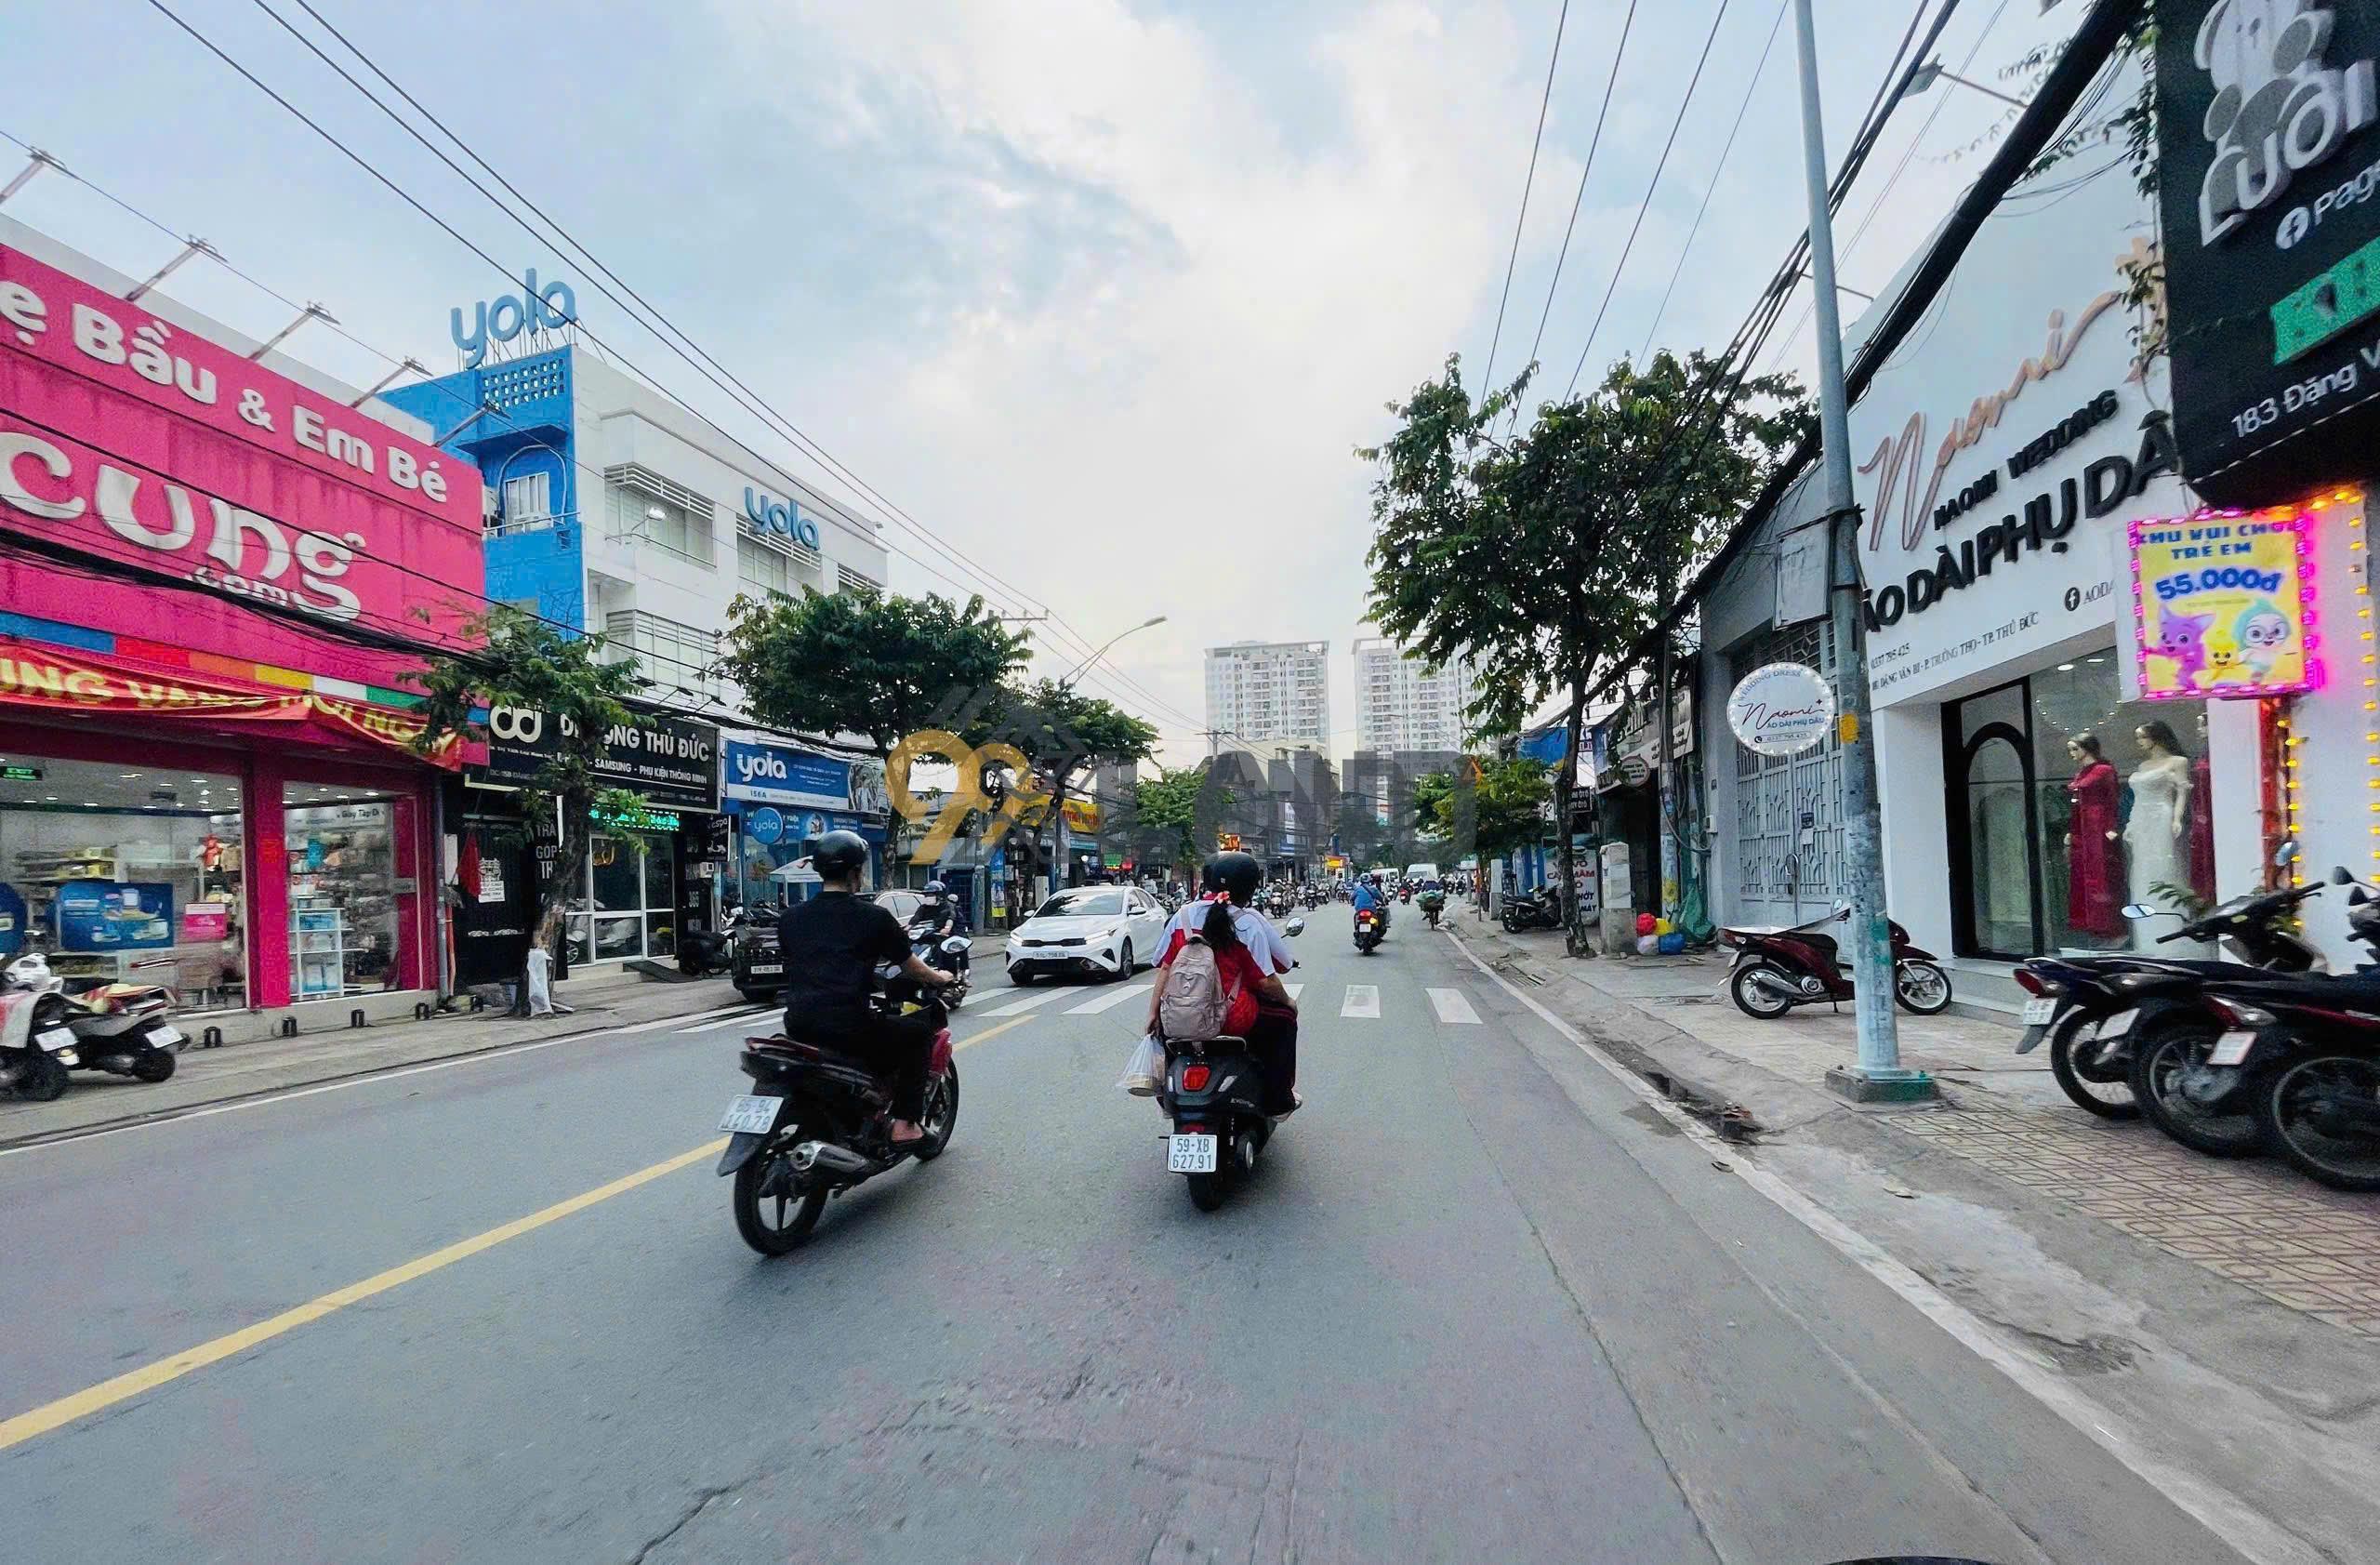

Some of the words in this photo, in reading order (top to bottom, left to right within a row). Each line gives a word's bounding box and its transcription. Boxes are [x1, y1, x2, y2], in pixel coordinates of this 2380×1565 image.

[451, 268, 578, 370] yola
[72, 303, 218, 405] Bầu
[238, 388, 276, 433] &
[293, 405, 375, 475] Em
[388, 445, 448, 503] Bé
[2231, 397, 2280, 438] 183
[2282, 363, 2359, 414] Đặng
[1934, 469, 1998, 531] NAOMI
[2006, 389, 2121, 480] WEDDING
[745, 486, 820, 551] yola
[2239, 522, 2294, 537] CH
[2220, 541, 2252, 556] EM
[2155, 567, 2281, 601] 55.000đ
[644, 727, 674, 756] THỦ
[678, 732, 710, 762] ĐỨC
[594, 758, 632, 773] SAMSUNG
[639, 764, 653, 778] PHỤ
[654, 765, 668, 781] KIỆN
[669, 769, 692, 783] THÔNG
[692, 773, 707, 785] MINH
[736, 751, 787, 782] yola
[750, 789, 767, 799] 156A
[754, 817, 778, 833] yola
[1177, 1138, 1210, 1153] 59-XB
[1172, 1154, 1211, 1169] 627.91
